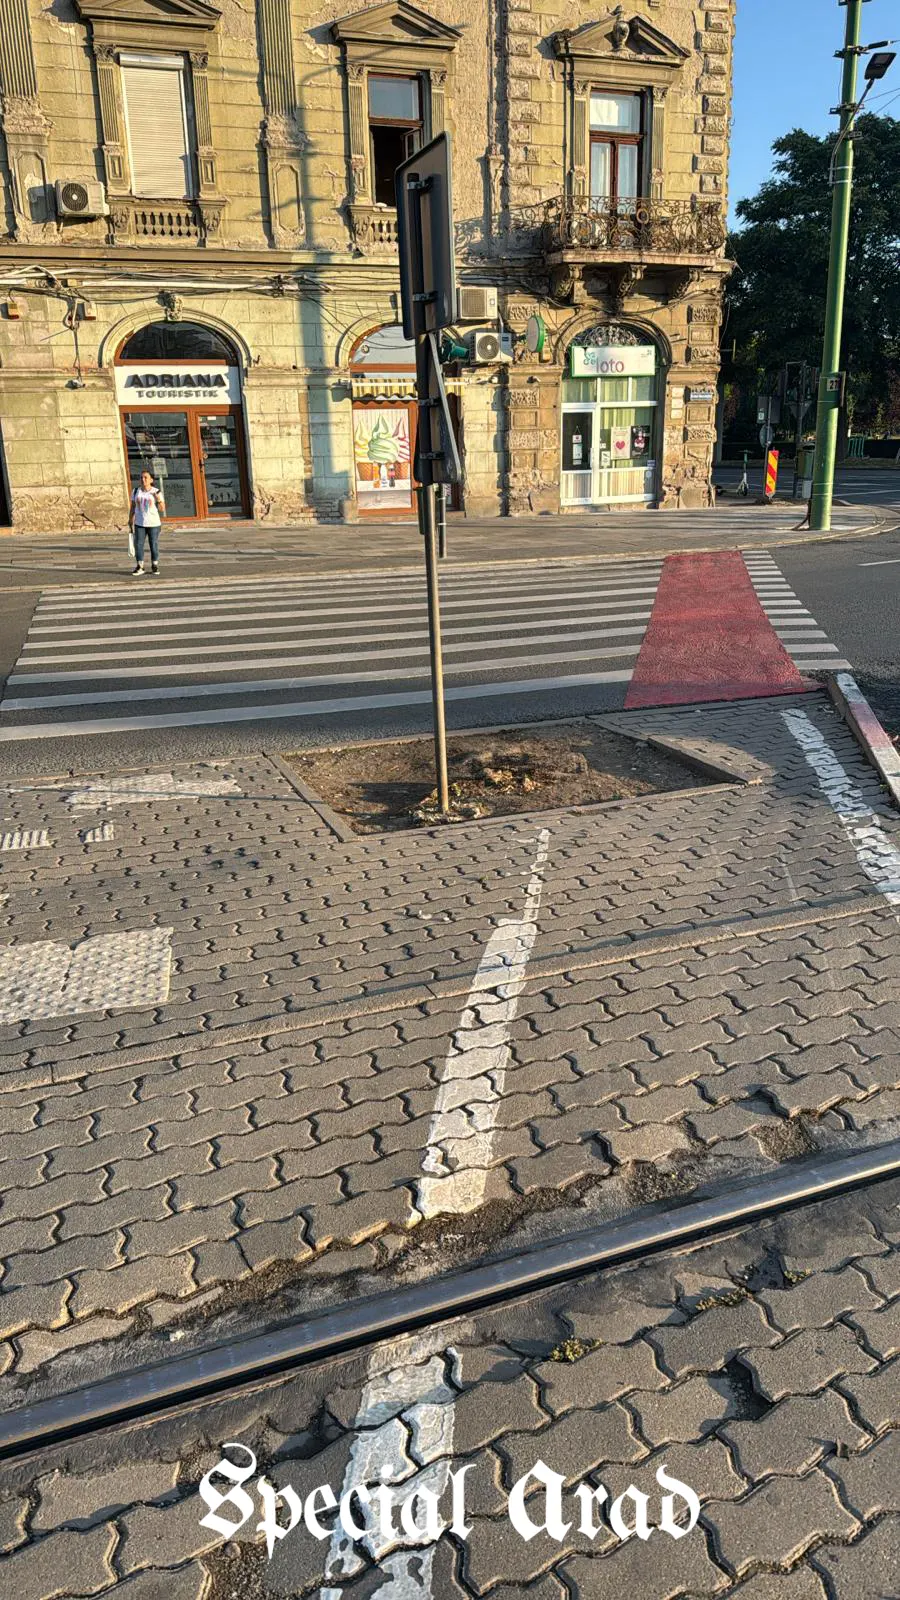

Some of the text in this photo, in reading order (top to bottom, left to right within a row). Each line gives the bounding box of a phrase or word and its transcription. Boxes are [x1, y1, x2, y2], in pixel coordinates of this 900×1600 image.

[596, 357, 624, 373] loto
[125, 374, 227, 388] ADRIANA
[136, 390, 218, 398] TOURISTIK
